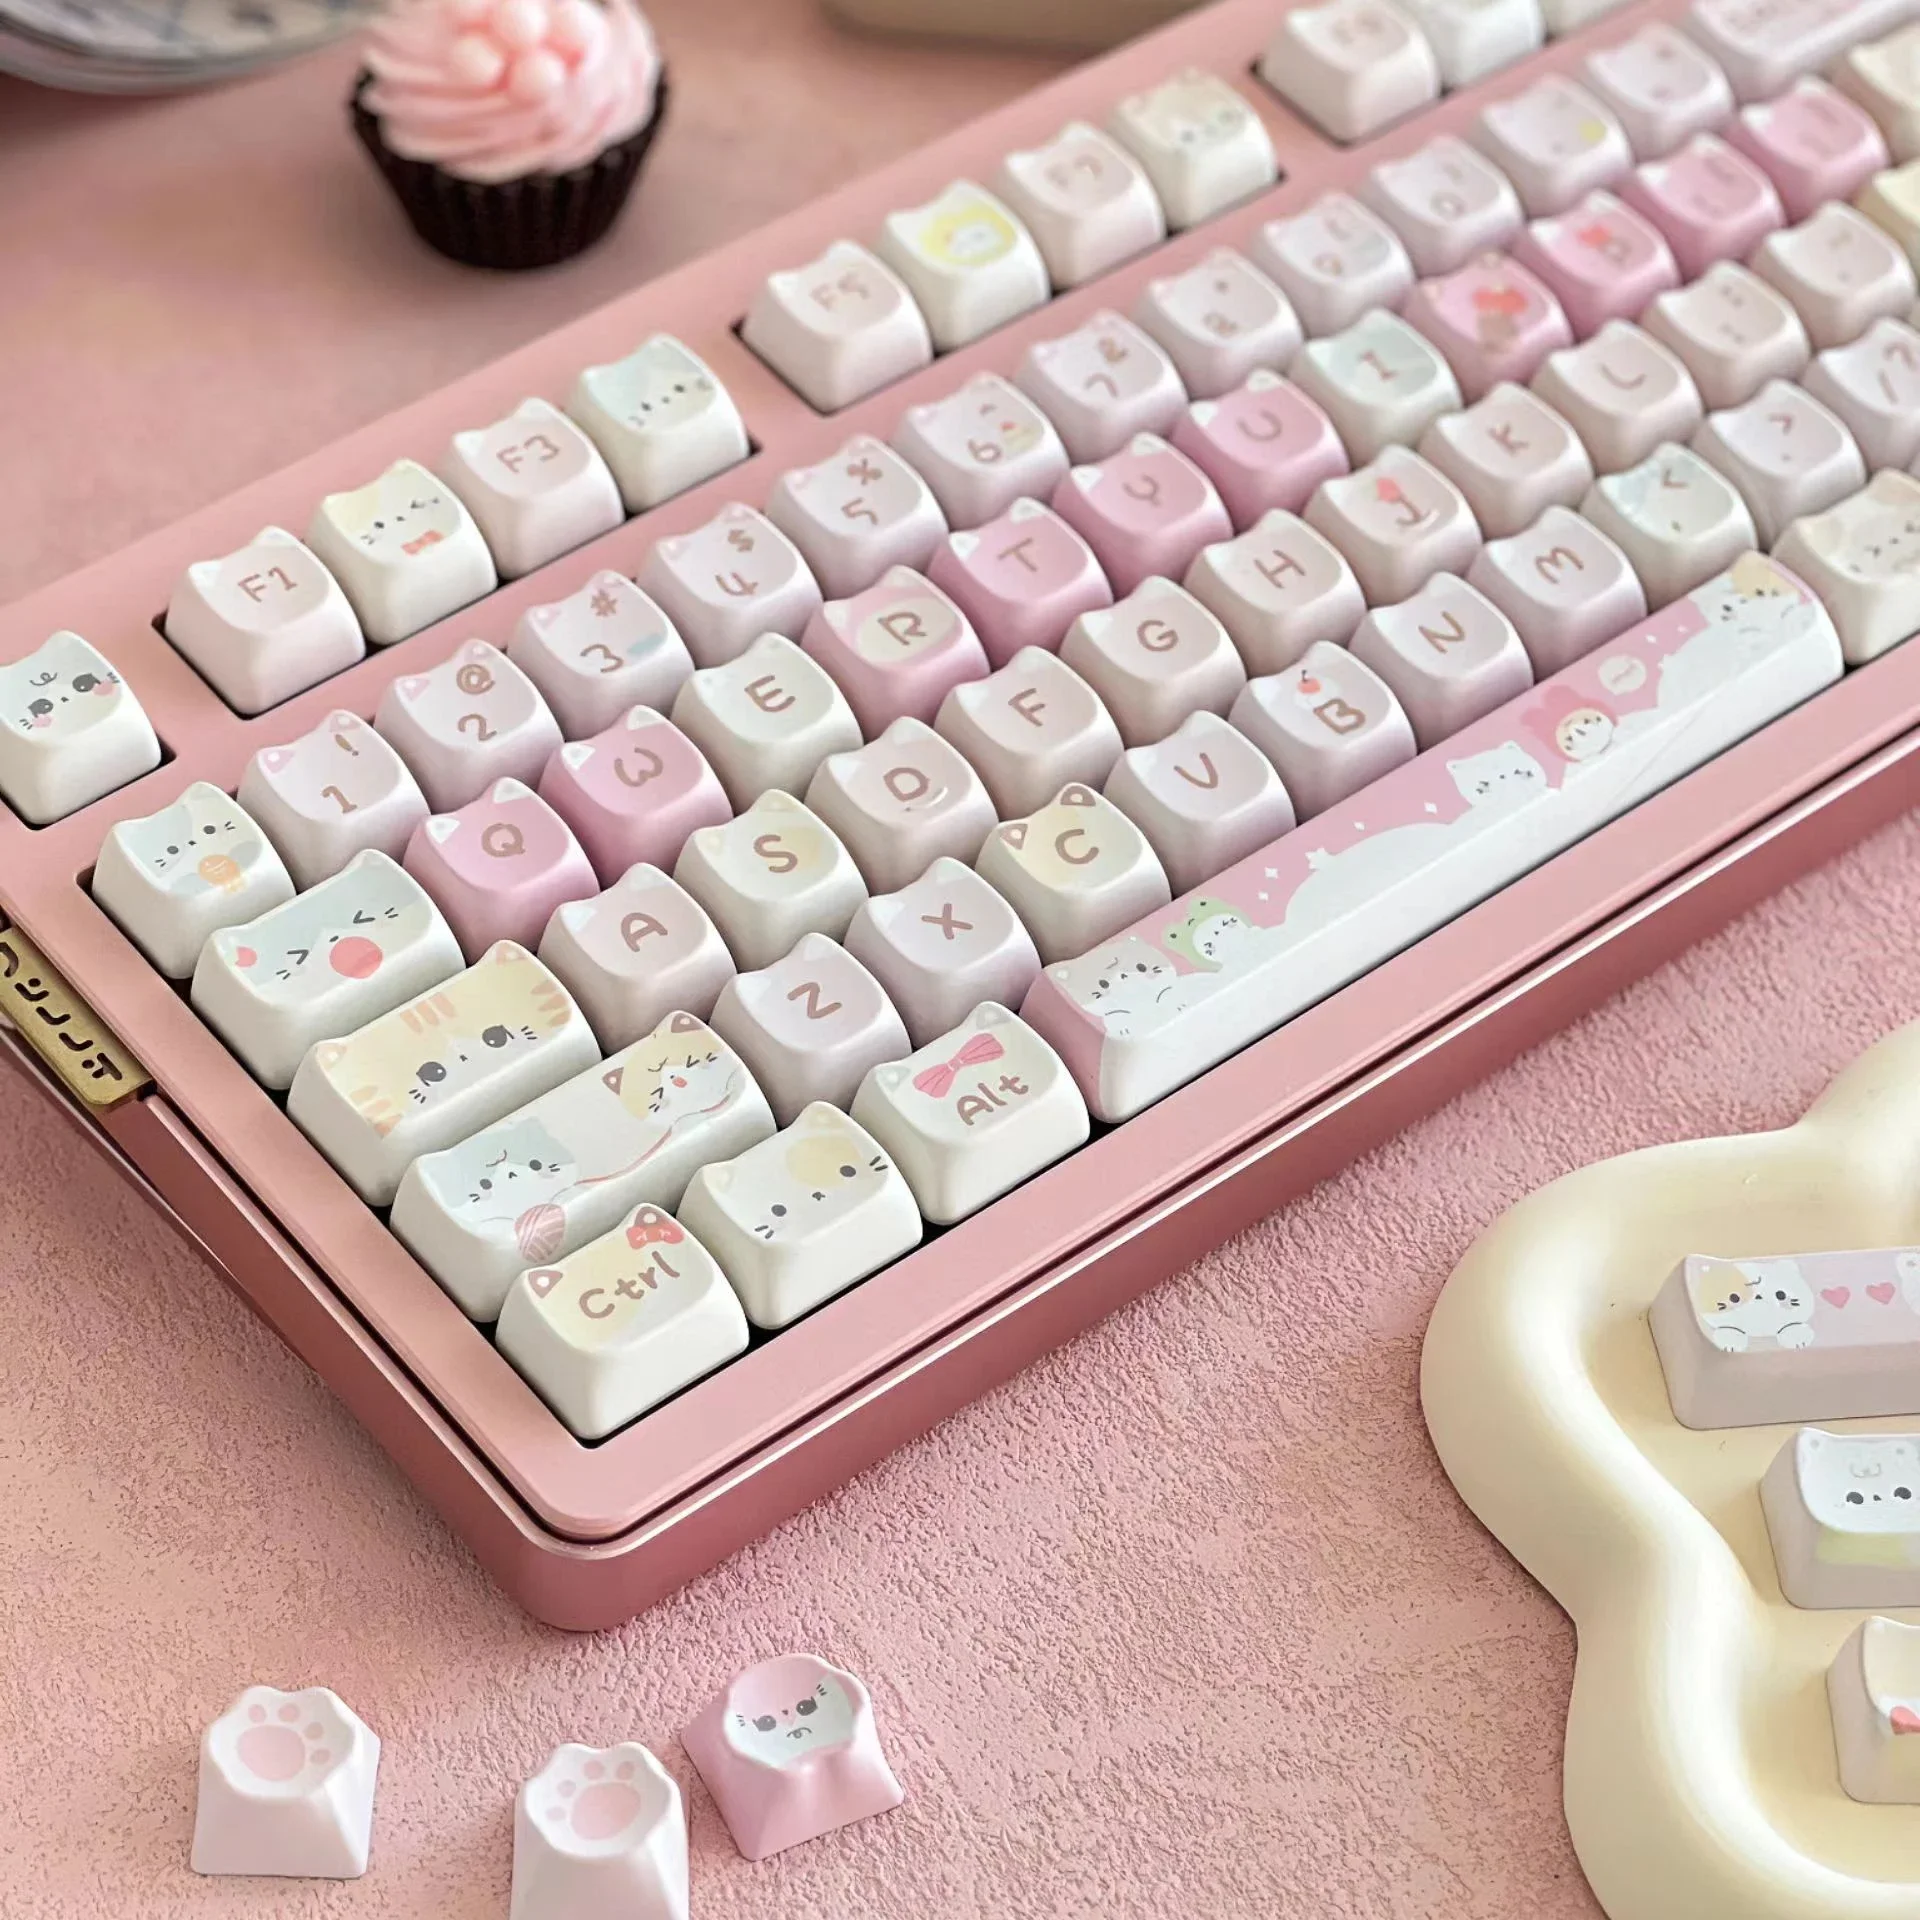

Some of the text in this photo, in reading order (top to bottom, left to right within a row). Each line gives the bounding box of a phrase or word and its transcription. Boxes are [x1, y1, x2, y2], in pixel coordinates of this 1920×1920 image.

[809, 270, 869, 311] F5
[1359, 351, 1398, 381] I
[1236, 408, 1283, 442] U
[1487, 421, 1529, 457] K
[497, 435, 559, 473] F3
[968, 438, 1003, 463] 6
[1122, 473, 1162, 507] Y
[841, 498, 879, 525] 5
[997, 537, 1038, 572] T
[1253, 549, 1306, 589] H
[1535, 546, 1584, 585] M
[238, 567, 297, 603] F1
[715, 572, 759, 596] 4
[877, 611, 927, 646] R
[1136, 618, 1179, 652] G
[1418, 610, 1466, 653] N
[580, 643, 623, 672] 3
[456, 664, 496, 695] @
[744, 675, 796, 713] E
[1007, 687, 1046, 727] F
[1313, 697, 1367, 735] B
[458, 714, 497, 741] 2
[614, 747, 664, 788] W
[882, 766, 931, 803] D
[1173, 752, 1220, 790] V
[322, 785, 357, 814] 1
[481, 822, 526, 858] Q
[753, 833, 798, 873] S
[1055, 828, 1099, 865] C
[620, 911, 668, 953] A
[921, 903, 974, 941] X
[787, 981, 842, 1020] Z
[956, 1075, 1029, 1126] Alt
[578, 1251, 680, 1319] Ctrl
